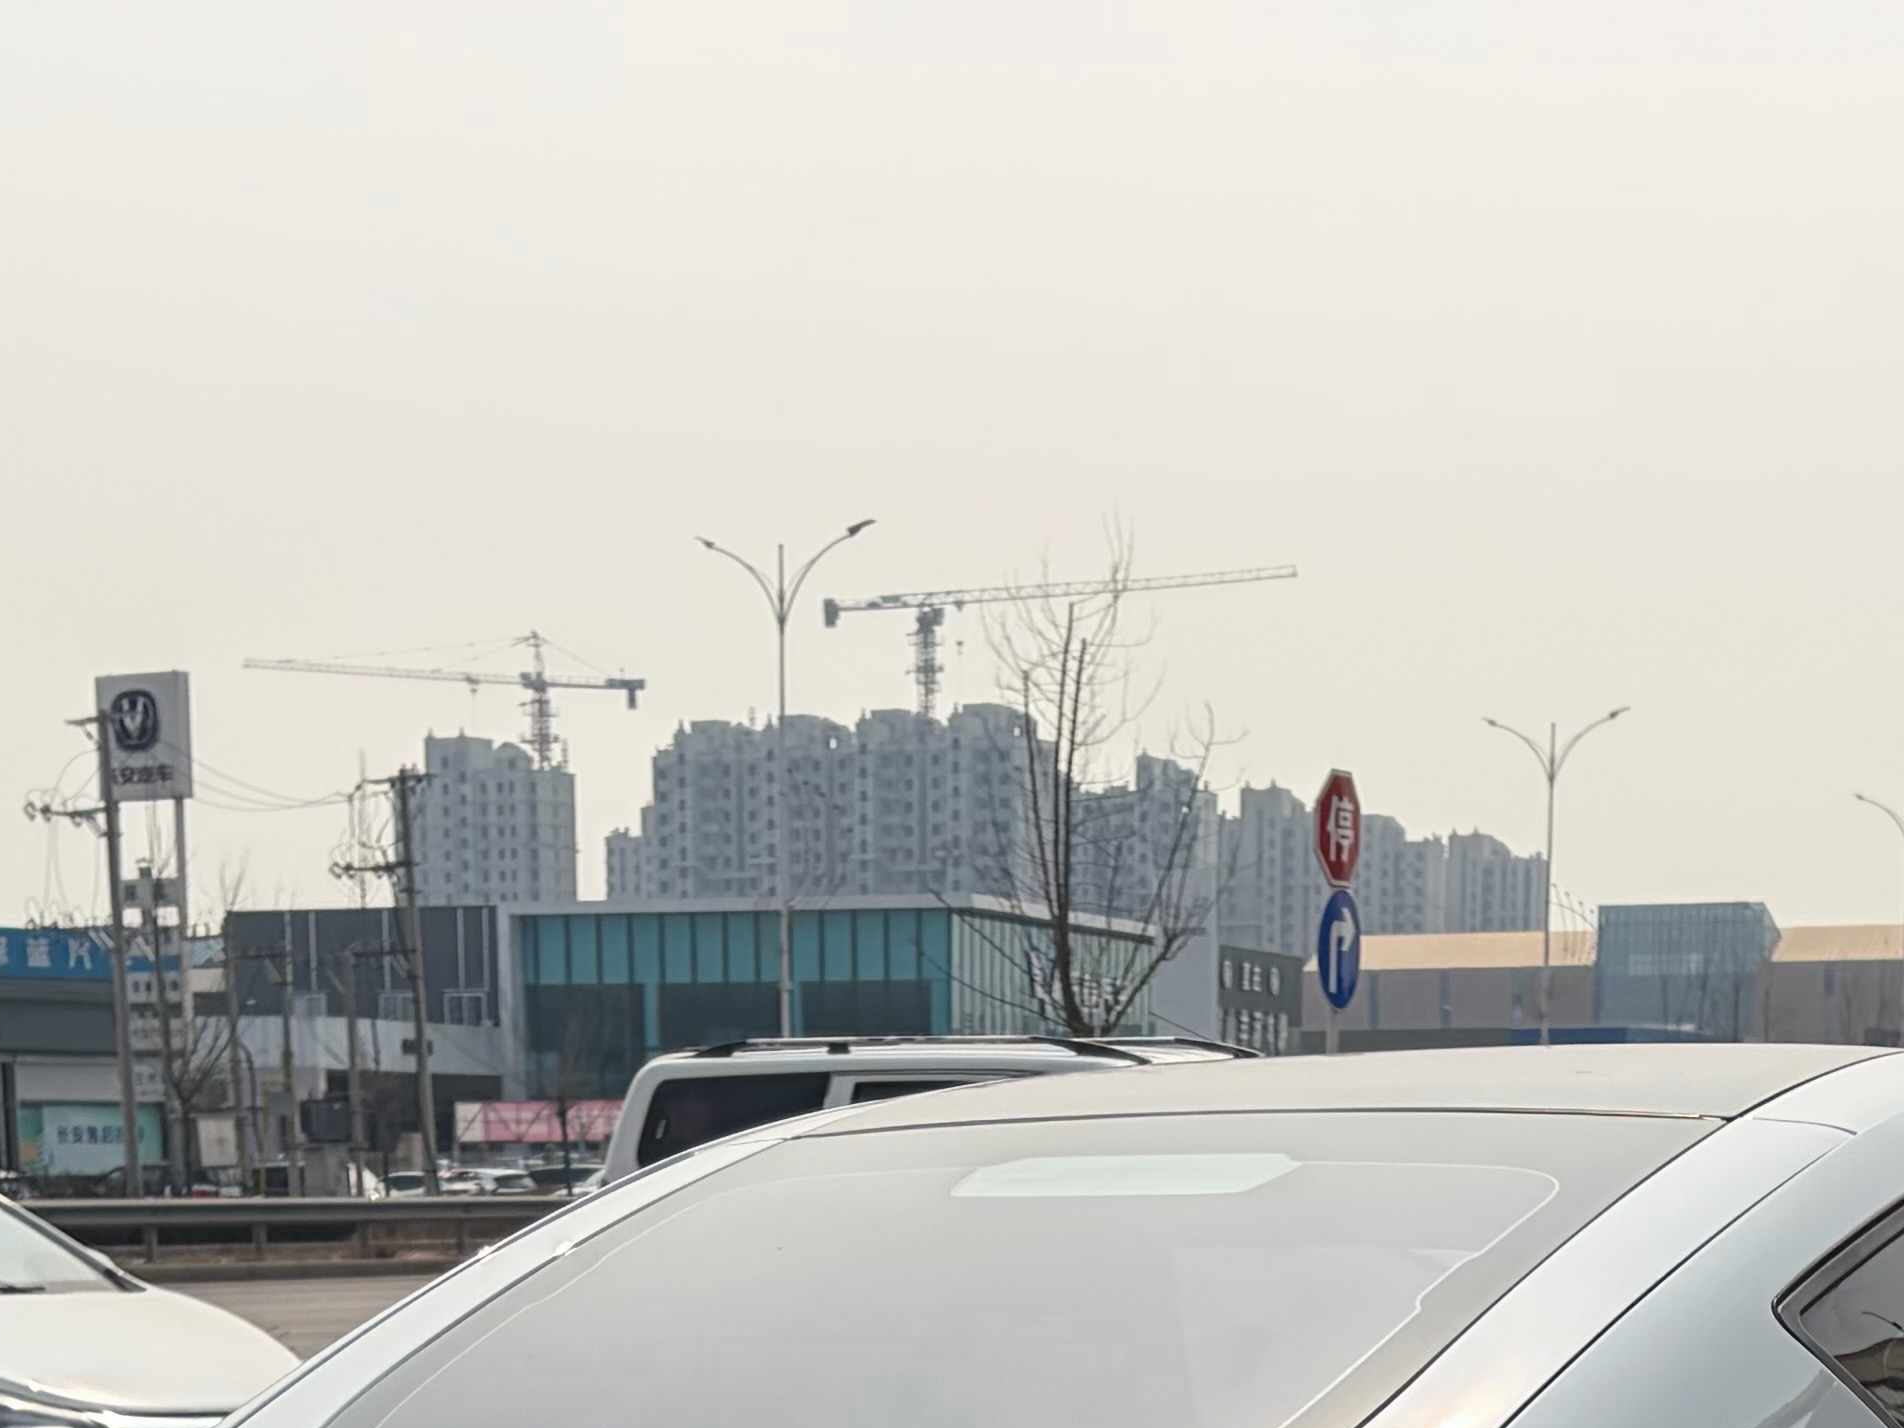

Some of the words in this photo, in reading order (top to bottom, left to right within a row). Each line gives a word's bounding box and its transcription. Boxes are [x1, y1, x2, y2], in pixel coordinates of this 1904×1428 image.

[111, 764, 174, 785] 安汽车
[1325, 795, 1356, 862] 停
